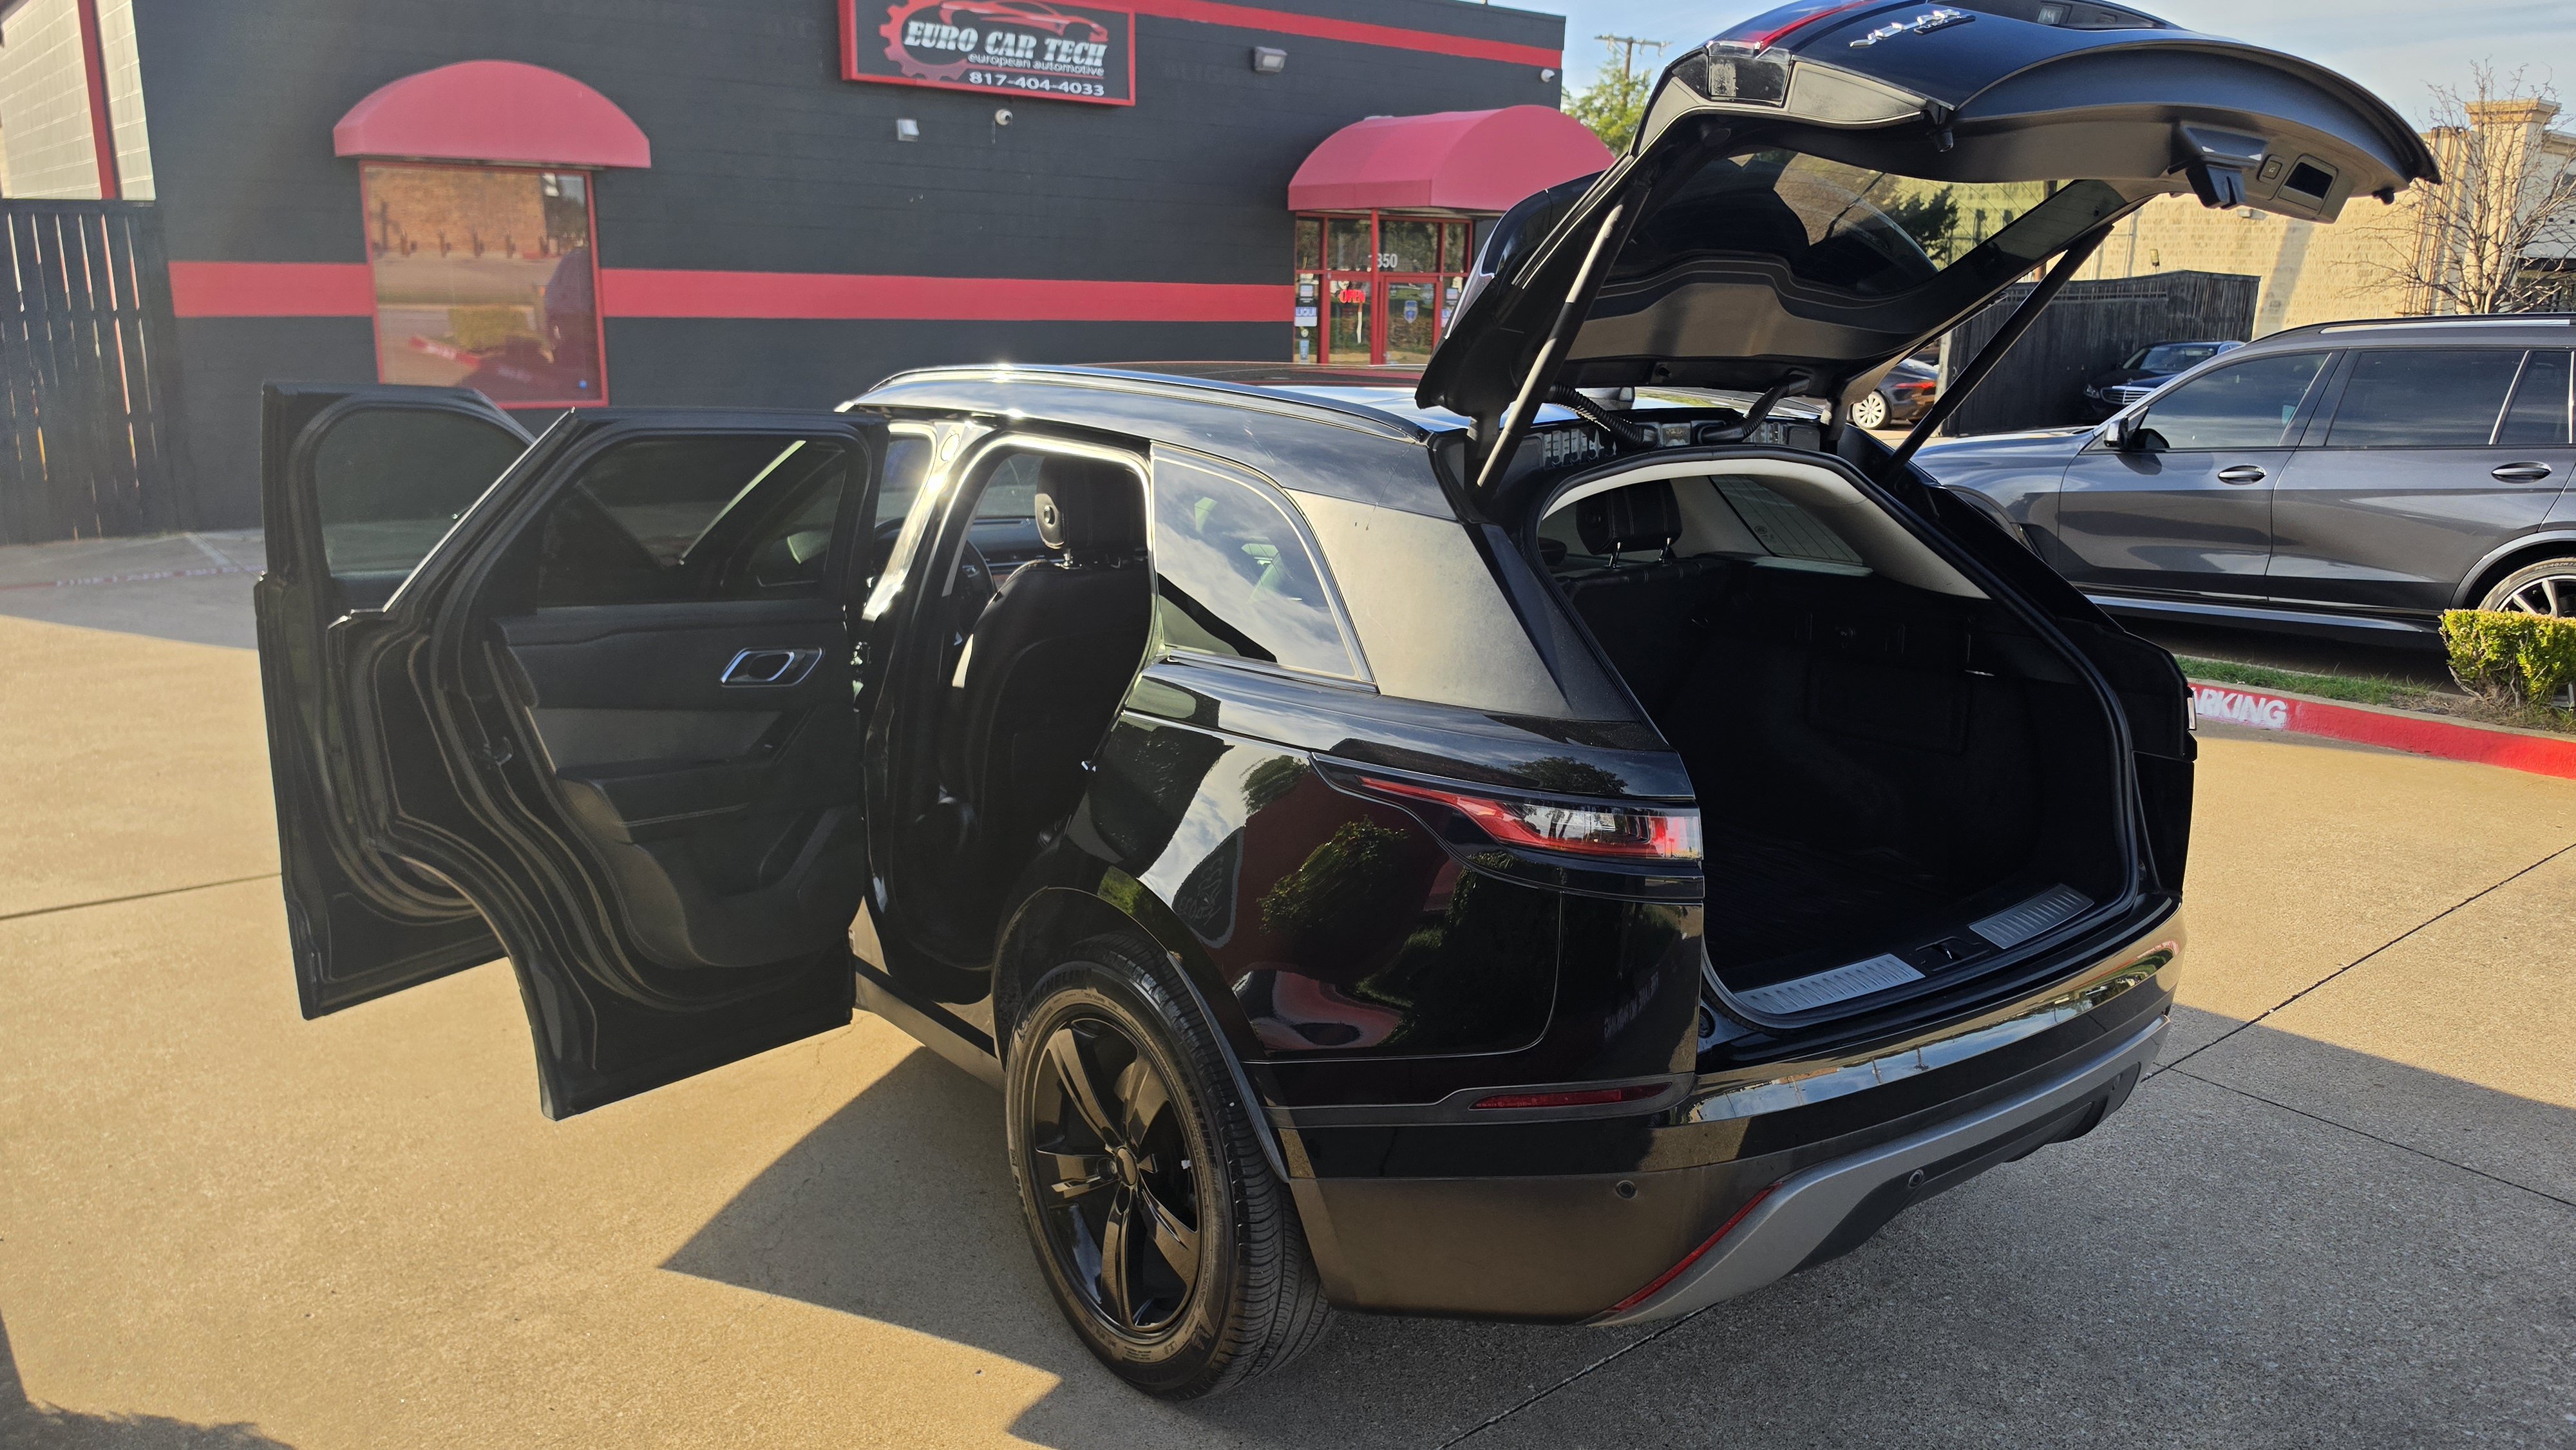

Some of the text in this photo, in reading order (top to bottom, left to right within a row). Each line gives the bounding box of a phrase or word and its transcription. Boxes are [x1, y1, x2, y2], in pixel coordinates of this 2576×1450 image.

[904, 21, 1108, 66] EURO CAR TECH
[967, 53, 1104, 76] european automotive
[969, 71, 1104, 96] 817-404-4033
[1339, 289, 1365, 303] OPEN
